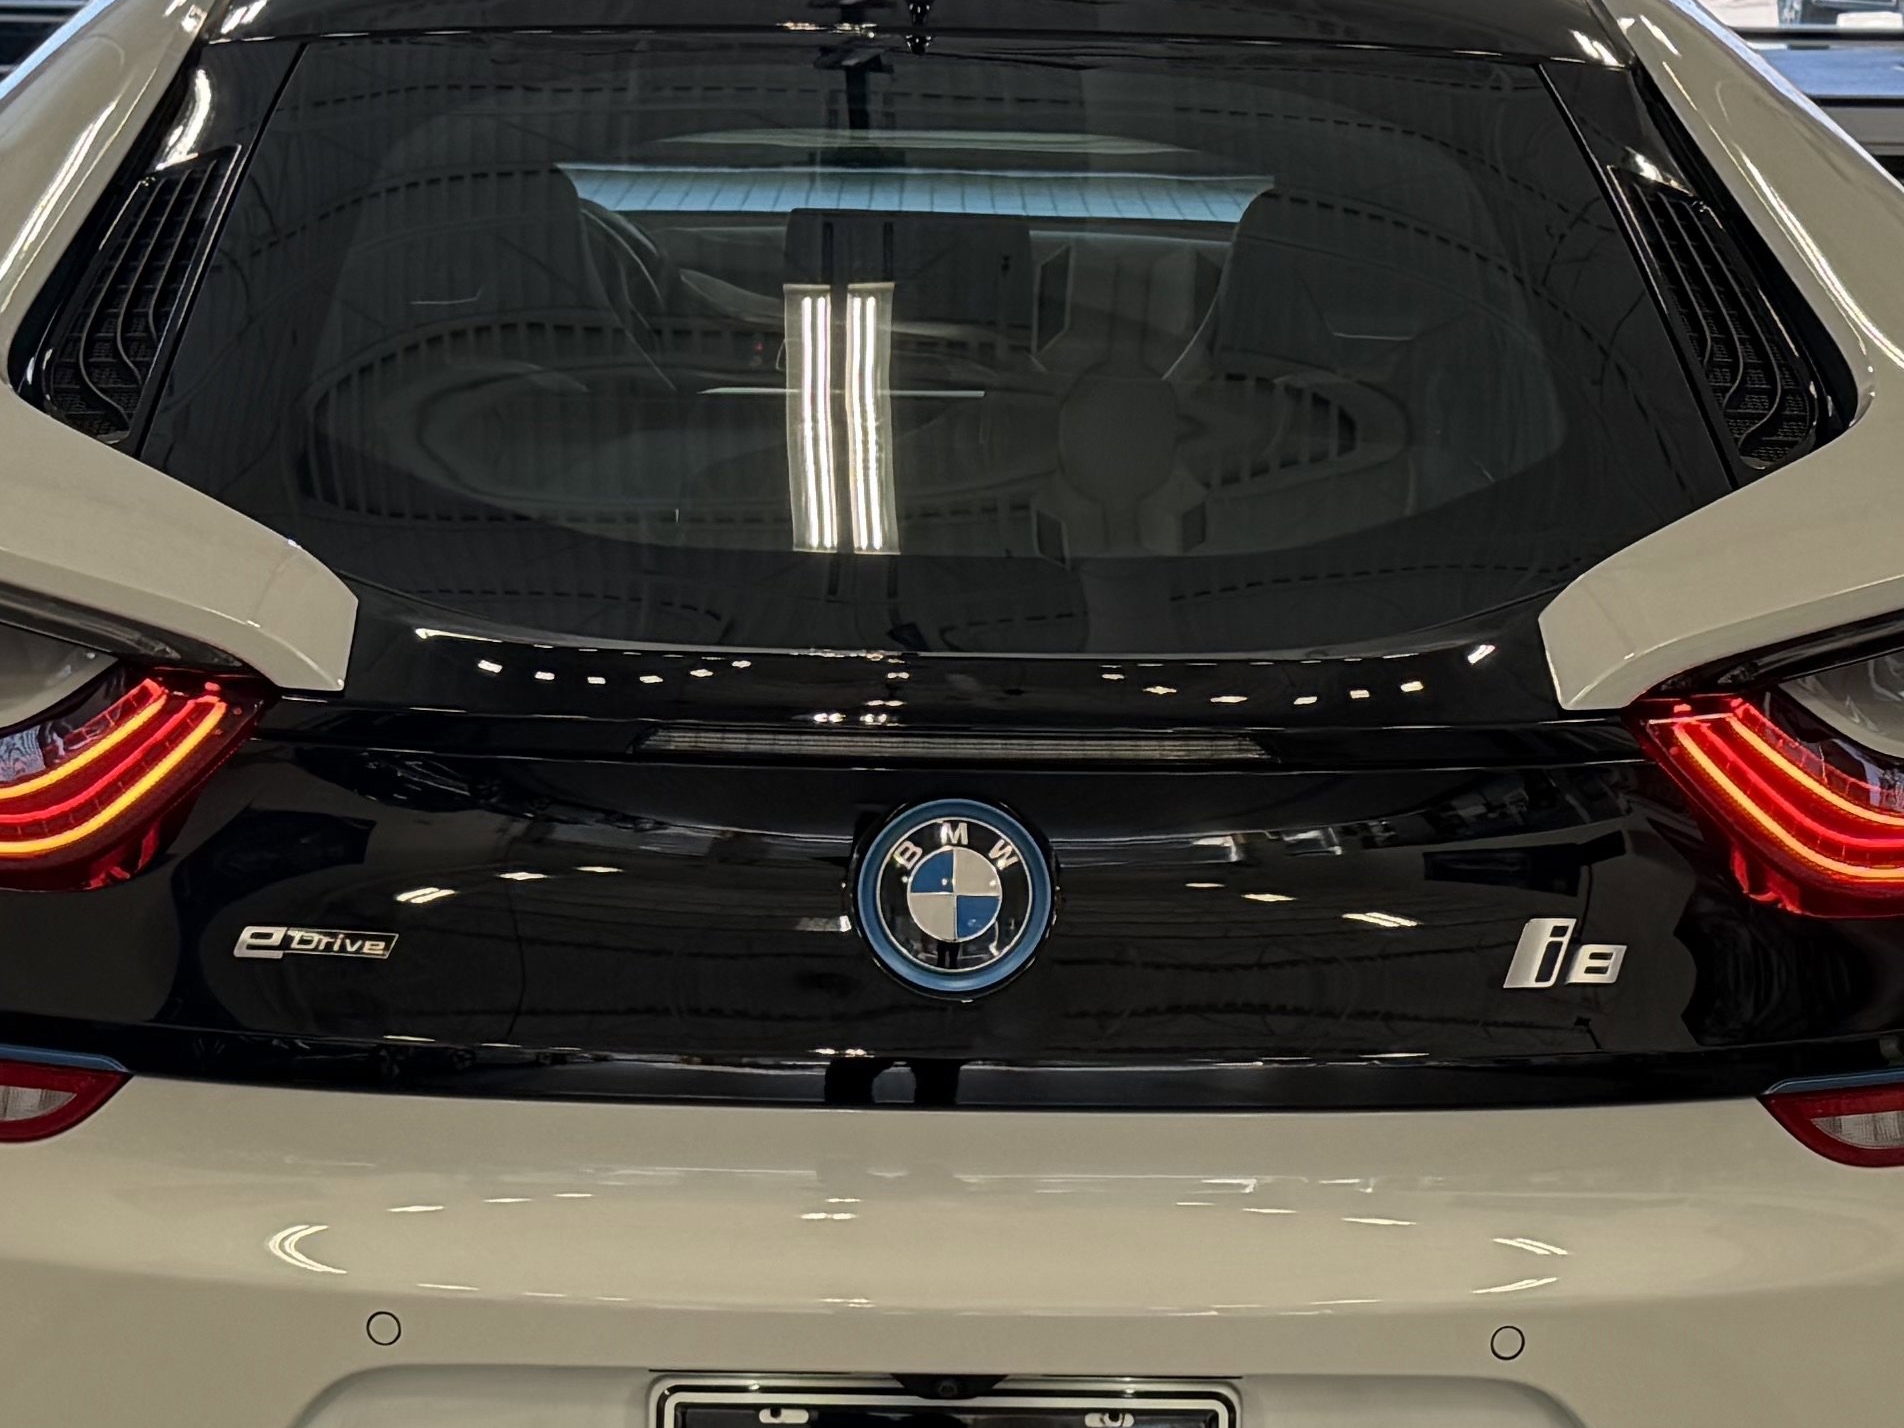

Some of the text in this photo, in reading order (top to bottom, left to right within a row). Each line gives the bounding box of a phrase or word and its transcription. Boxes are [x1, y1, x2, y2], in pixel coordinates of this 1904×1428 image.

[893, 822, 1020, 871] BMW
[233, 925, 399, 960] eDrive
[1503, 917, 1627, 989] i8
